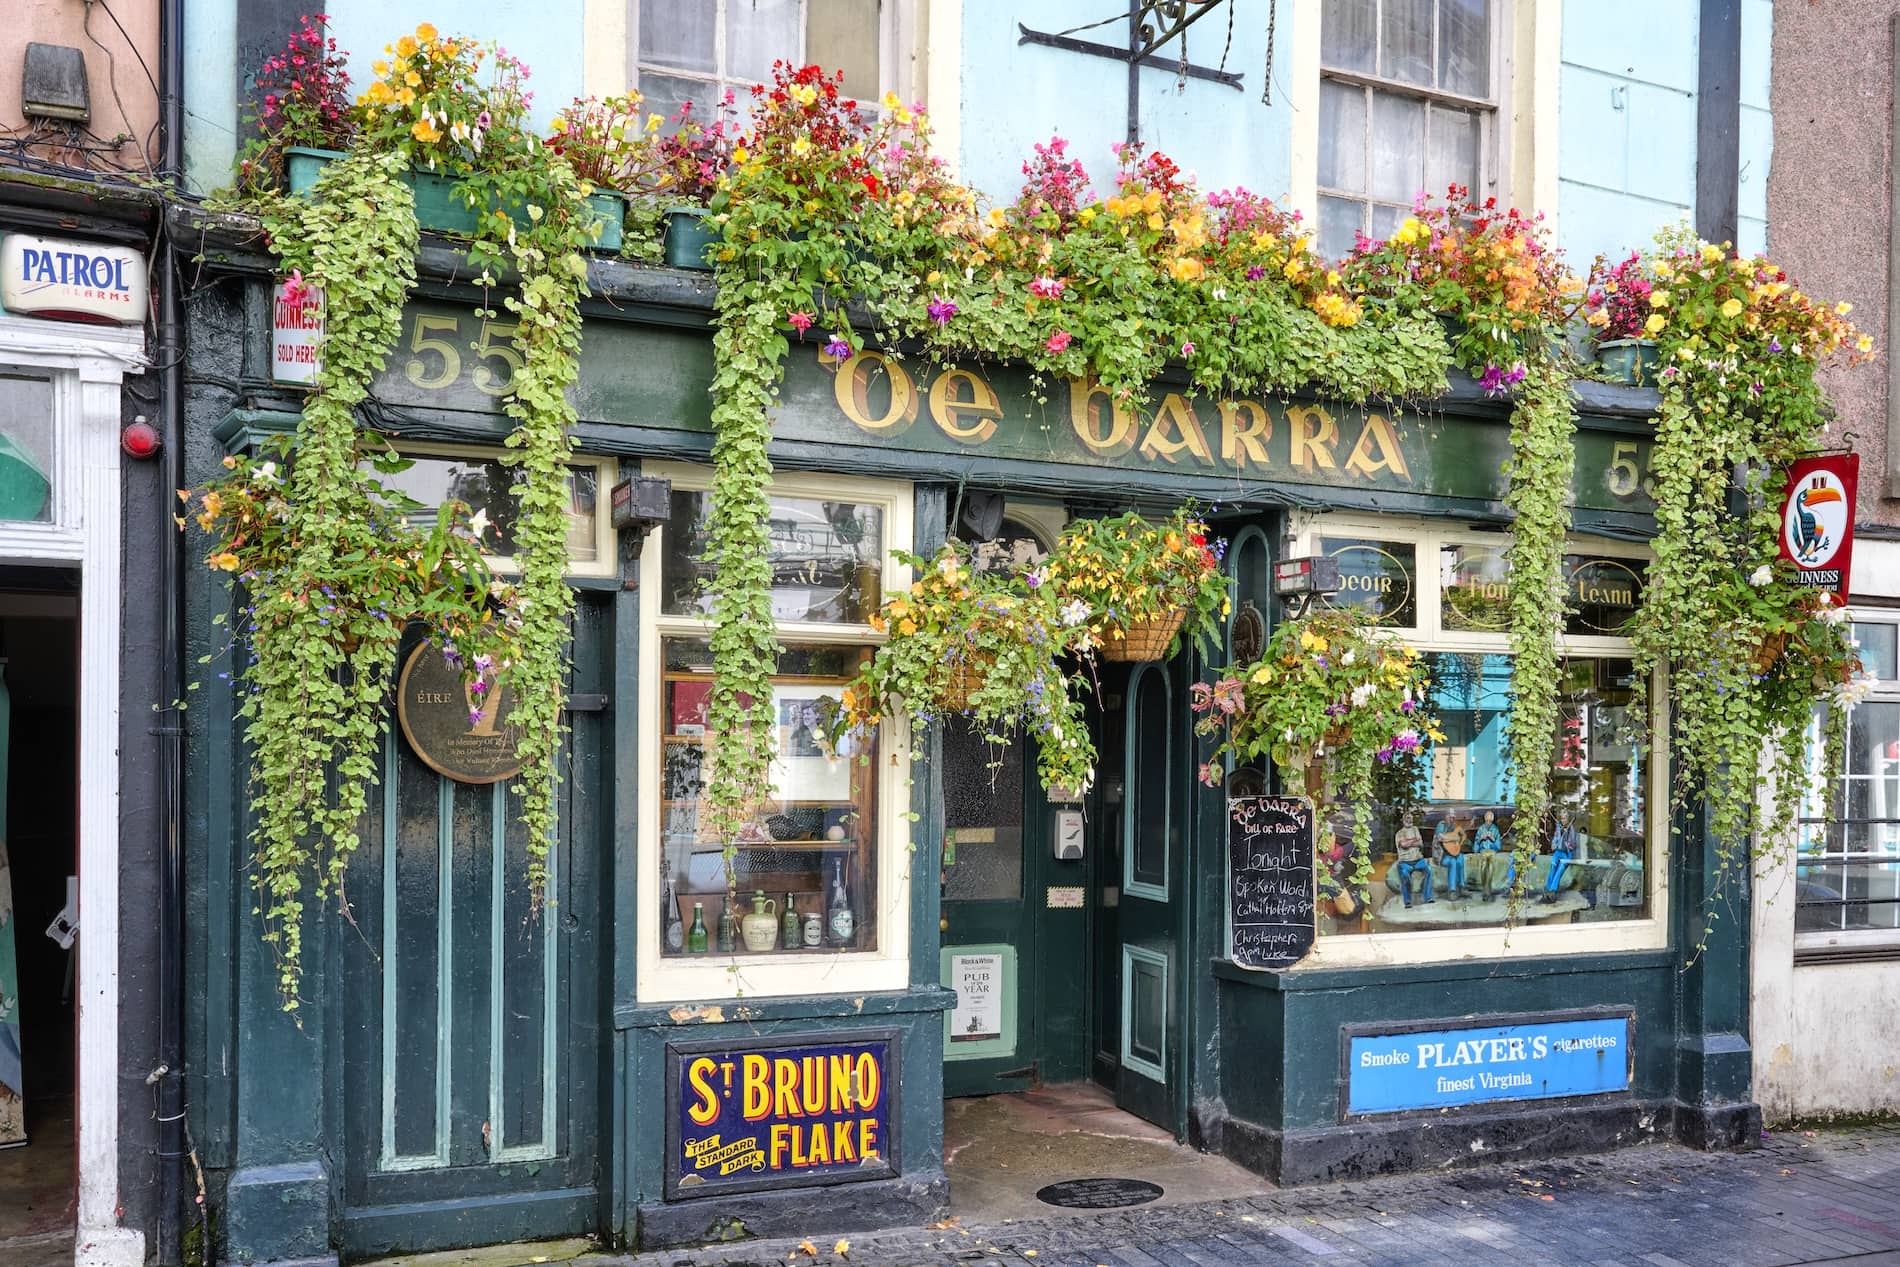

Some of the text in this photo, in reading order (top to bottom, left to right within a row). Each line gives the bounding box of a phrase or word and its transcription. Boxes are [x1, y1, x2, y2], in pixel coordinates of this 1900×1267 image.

[23, 248, 129, 291] PATROL
[274, 296, 321, 330] GUINNESS
[277, 344, 316, 364] SOLD HERE
[405, 313, 526, 397] 55
[417, 688, 452, 704] ÉIRE
[1243, 833, 1301, 883] Tonight
[1235, 875, 1307, 898] Spoken Word
[964, 972, 991, 982] PUB
[964, 984, 991, 993] YEAR
[1360, 1034, 1617, 1069] Smoke PLAYER'S cigarettes
[743, 1051, 881, 1122] BRUNO
[1436, 1071, 1532, 1093] finest Virginia
[692, 1140, 714, 1154] THE
[699, 1139, 755, 1167] STANDARD
[770, 1118, 881, 1170] FLAKE
[727, 1153, 759, 1172] DARK
